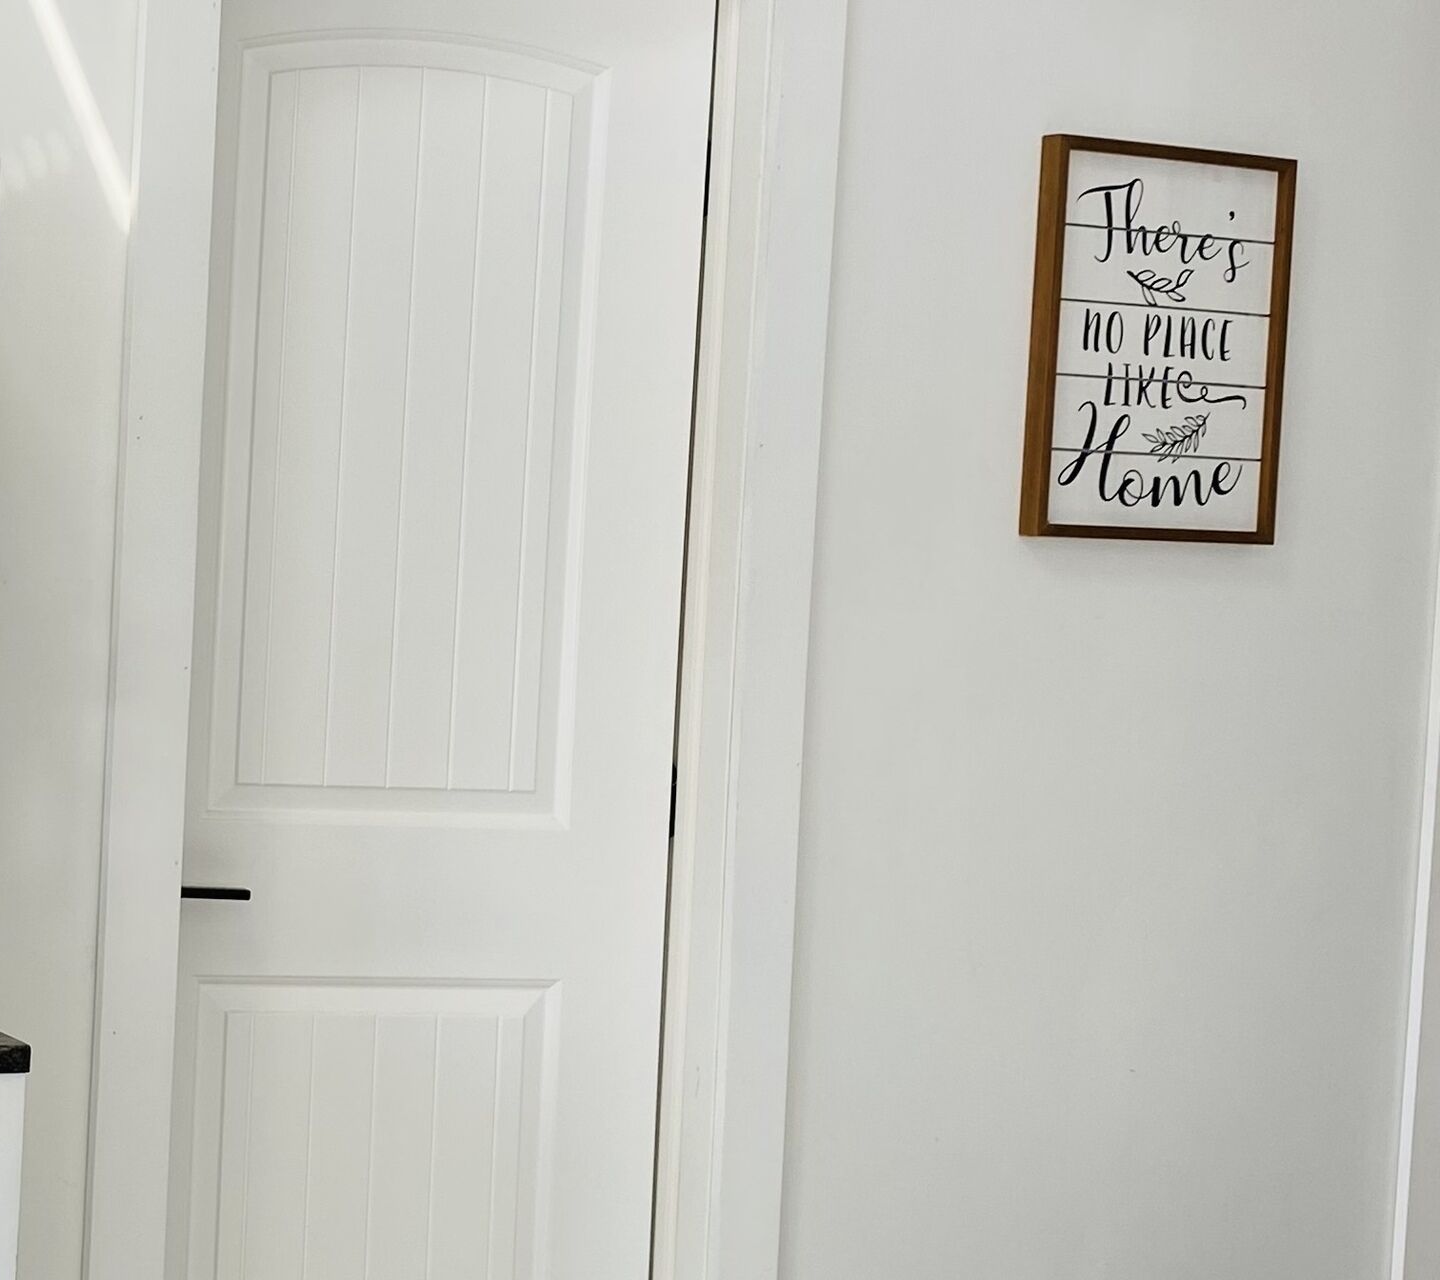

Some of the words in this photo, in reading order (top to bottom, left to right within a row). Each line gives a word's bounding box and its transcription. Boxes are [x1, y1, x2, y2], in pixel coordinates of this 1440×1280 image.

[1076, 177, 1250, 284] There's
[1082, 307, 1124, 354] NO
[1143, 313, 1234, 362] PLACE
[1103, 361, 1175, 410] LIKE
[1057, 400, 1244, 508] Home
